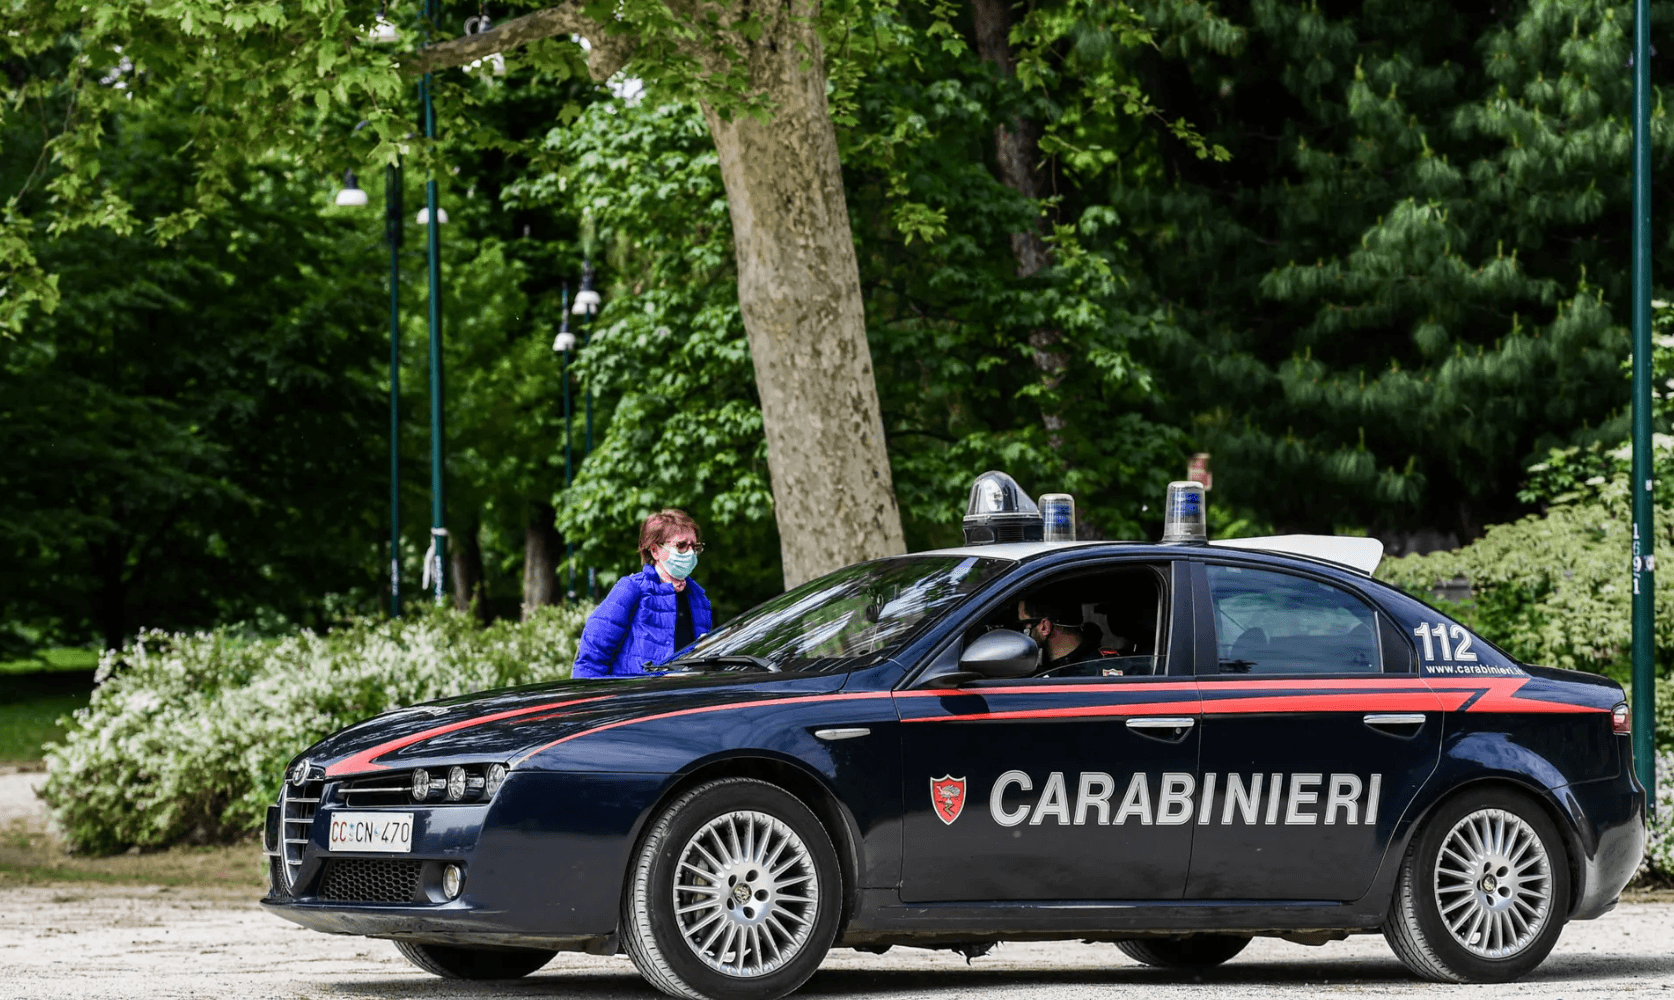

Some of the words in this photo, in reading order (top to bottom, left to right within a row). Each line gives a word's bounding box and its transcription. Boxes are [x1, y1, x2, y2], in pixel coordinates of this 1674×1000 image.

[1414, 622, 1478, 661] 112
[989, 769, 1382, 827] CARABINIERI
[381, 822, 410, 843] 470
